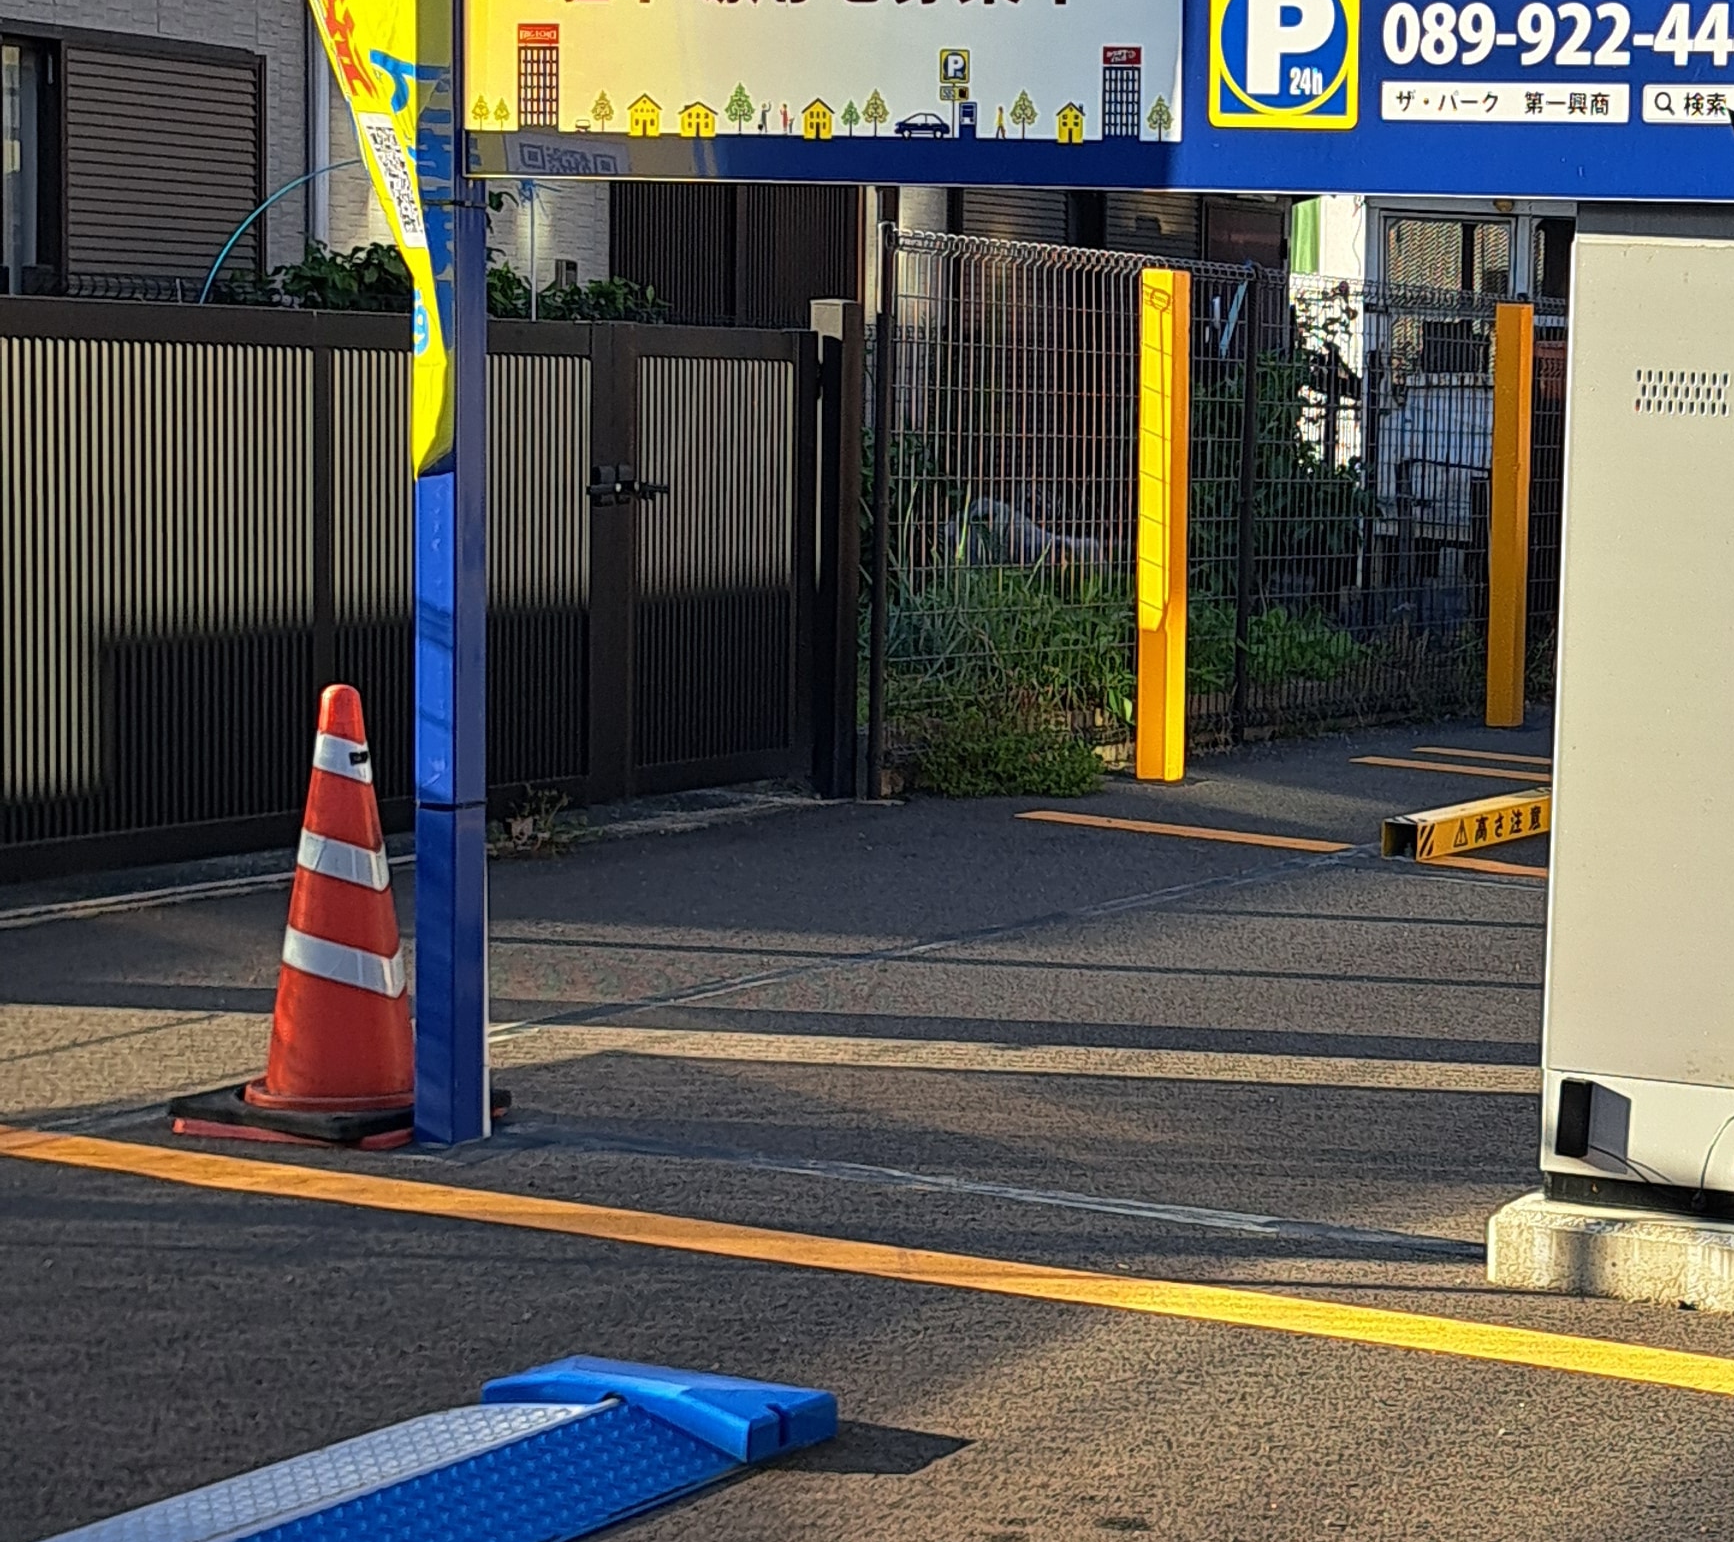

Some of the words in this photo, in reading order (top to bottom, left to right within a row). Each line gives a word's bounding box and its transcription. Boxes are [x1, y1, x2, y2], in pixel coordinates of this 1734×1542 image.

[1289, 66, 1323, 95] 24h
[1524, 90, 1611, 116] 第一興商
[1683, 92, 1728, 117] 検索
[1475, 805, 1542, 844] 高さ注意
